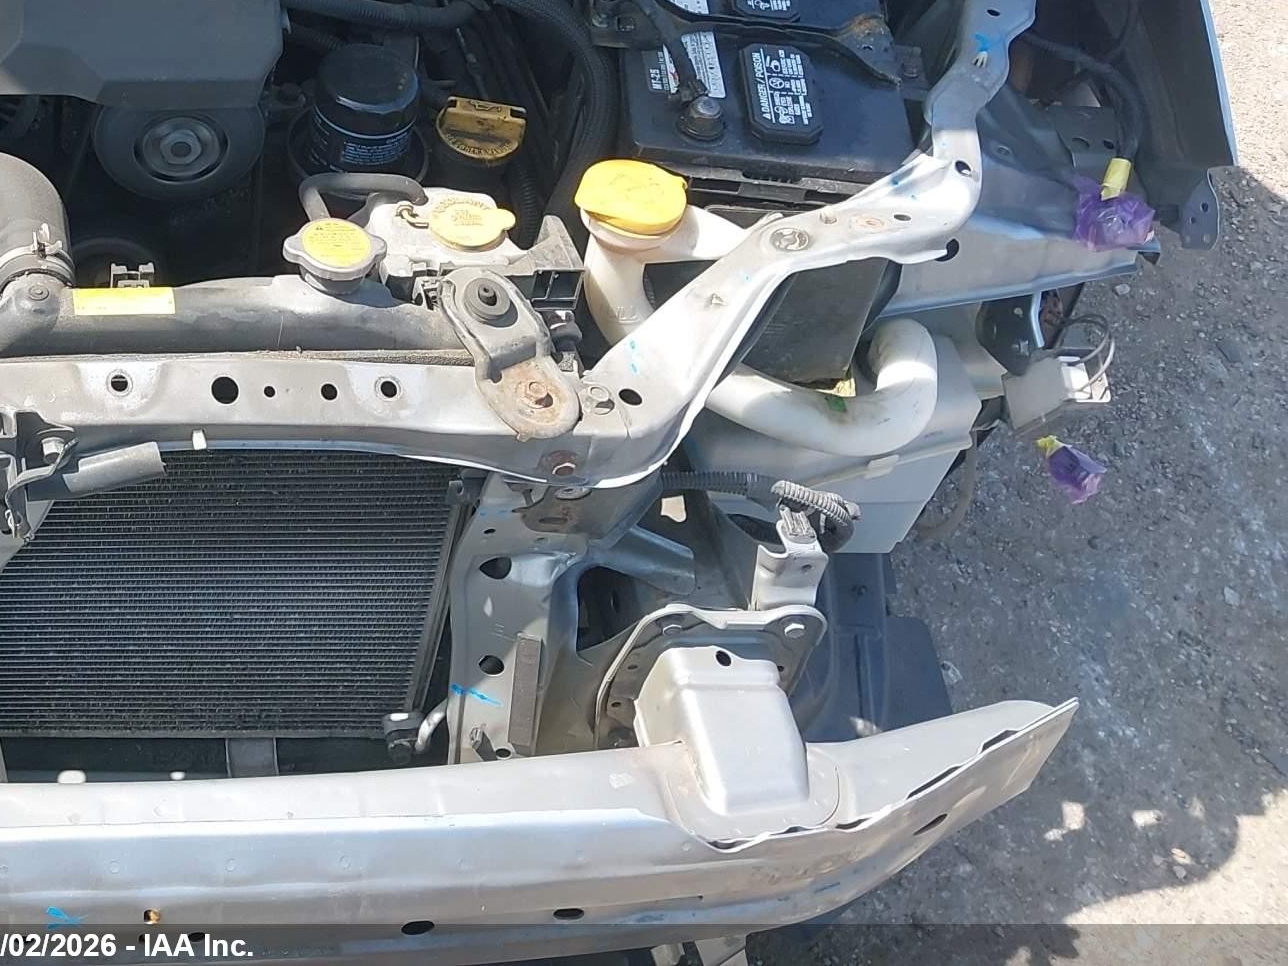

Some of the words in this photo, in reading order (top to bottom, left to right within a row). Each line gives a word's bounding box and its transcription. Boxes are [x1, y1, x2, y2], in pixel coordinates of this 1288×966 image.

[751, 52, 765, 78] POISON
[649, 68, 661, 90] MT-25
[757, 84, 770, 114] DANGER
